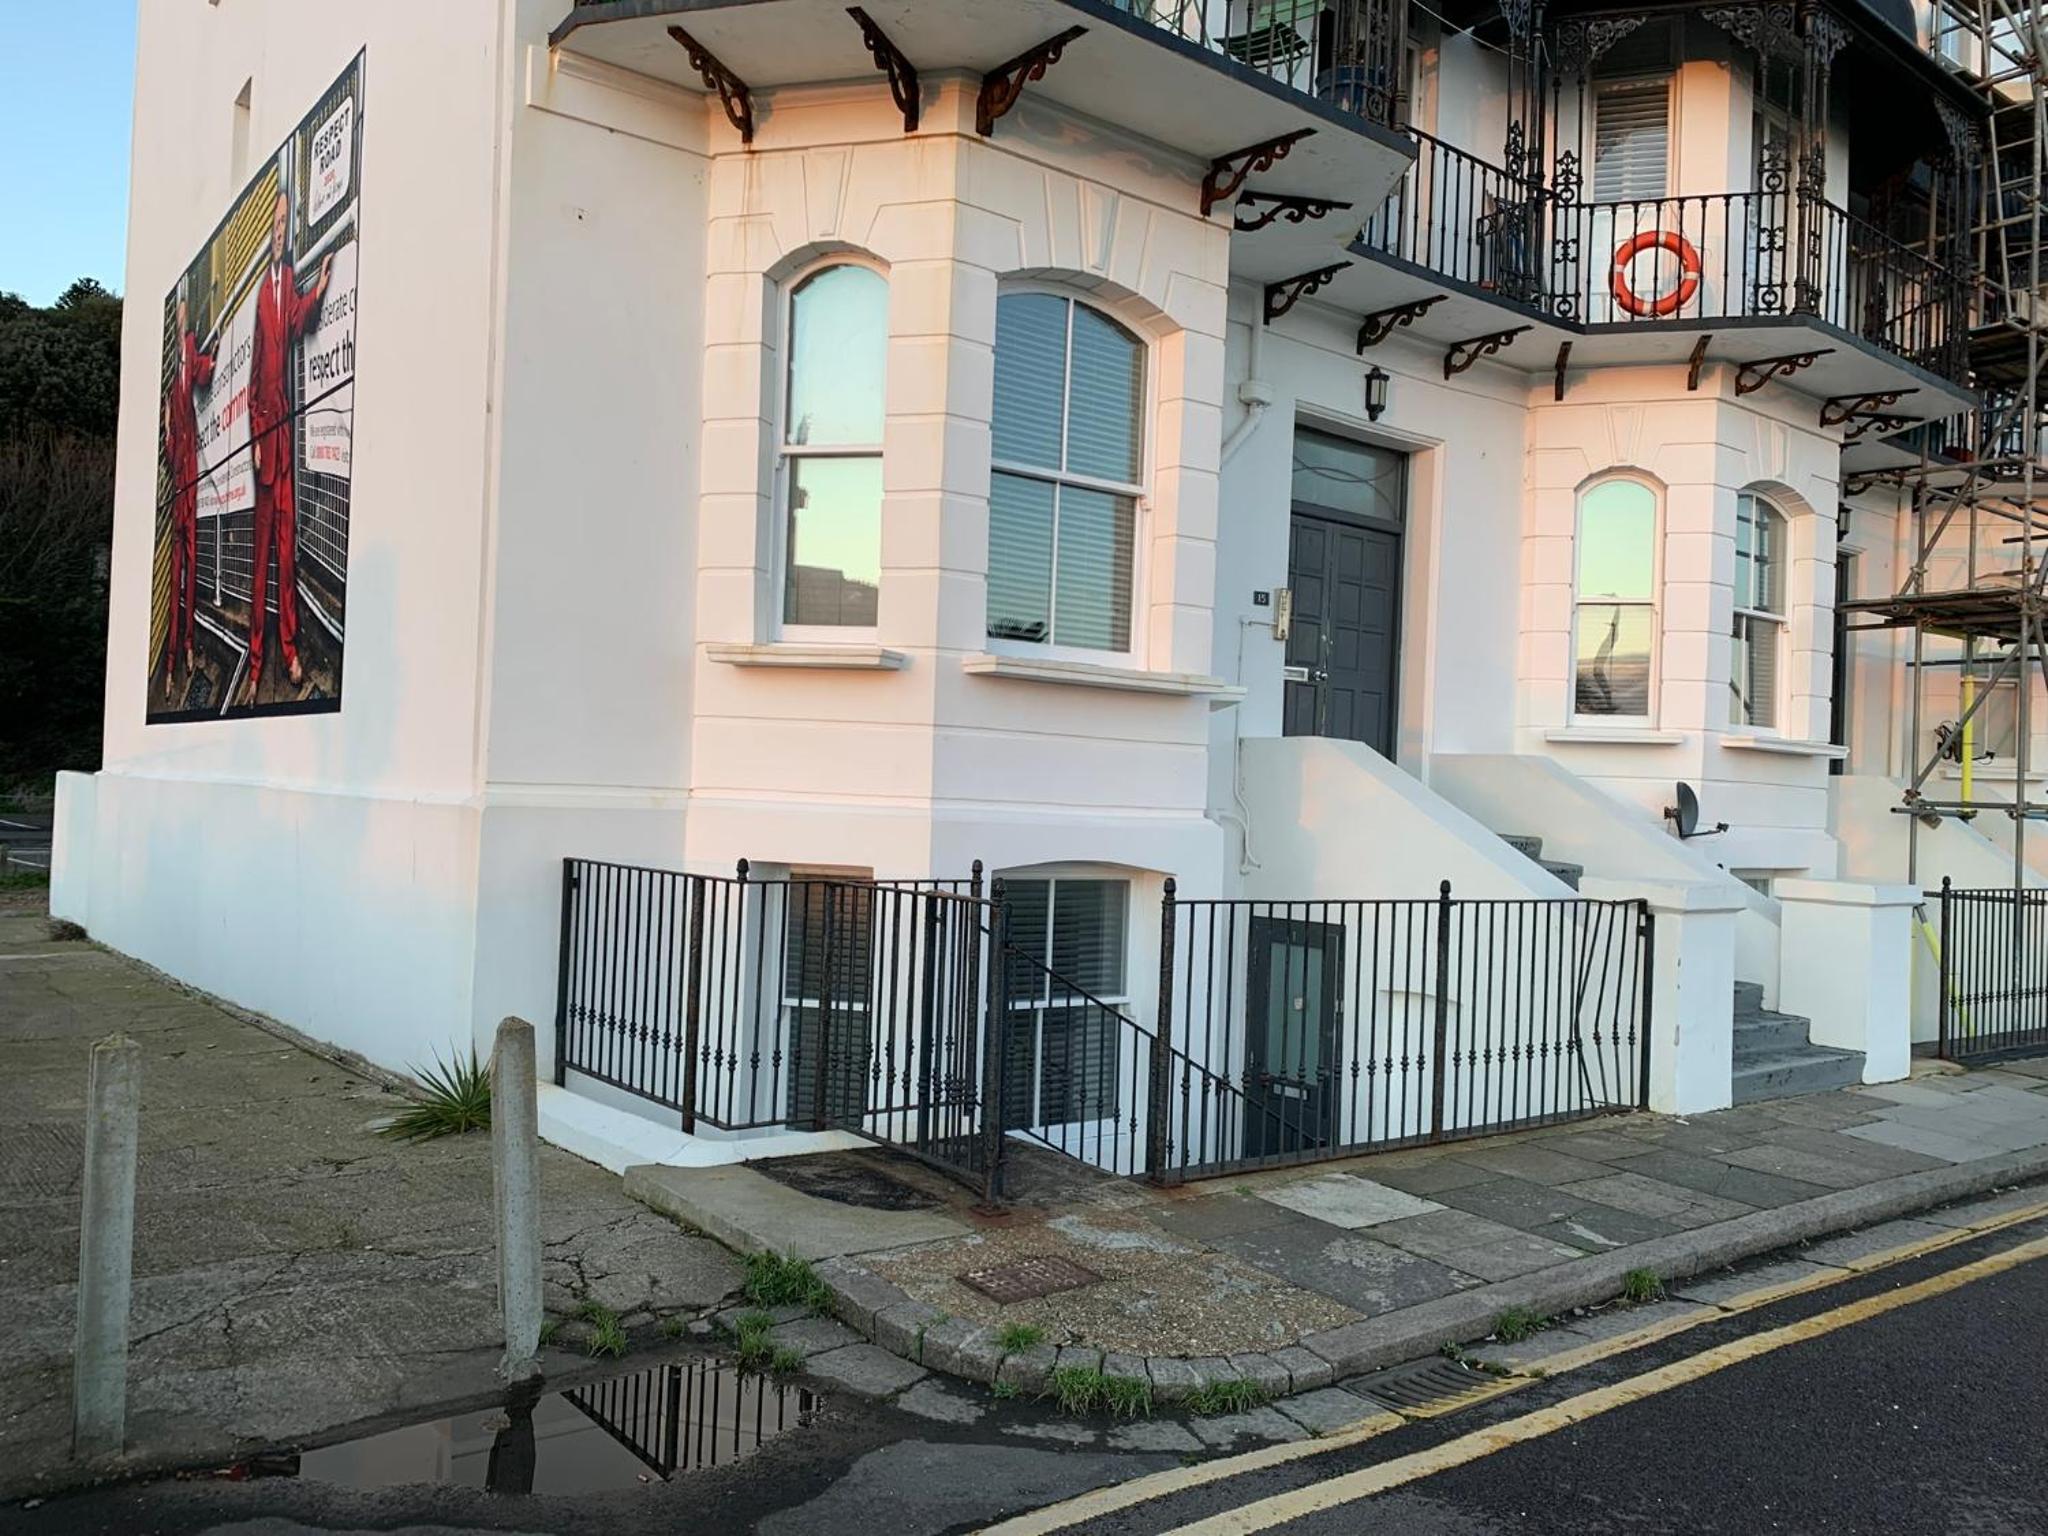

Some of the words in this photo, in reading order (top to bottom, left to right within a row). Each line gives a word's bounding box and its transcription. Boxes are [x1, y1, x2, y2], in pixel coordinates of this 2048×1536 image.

[314, 106, 350, 160] RESPECT
[320, 138, 342, 175] ROAD
[309, 341, 340, 388] respect
